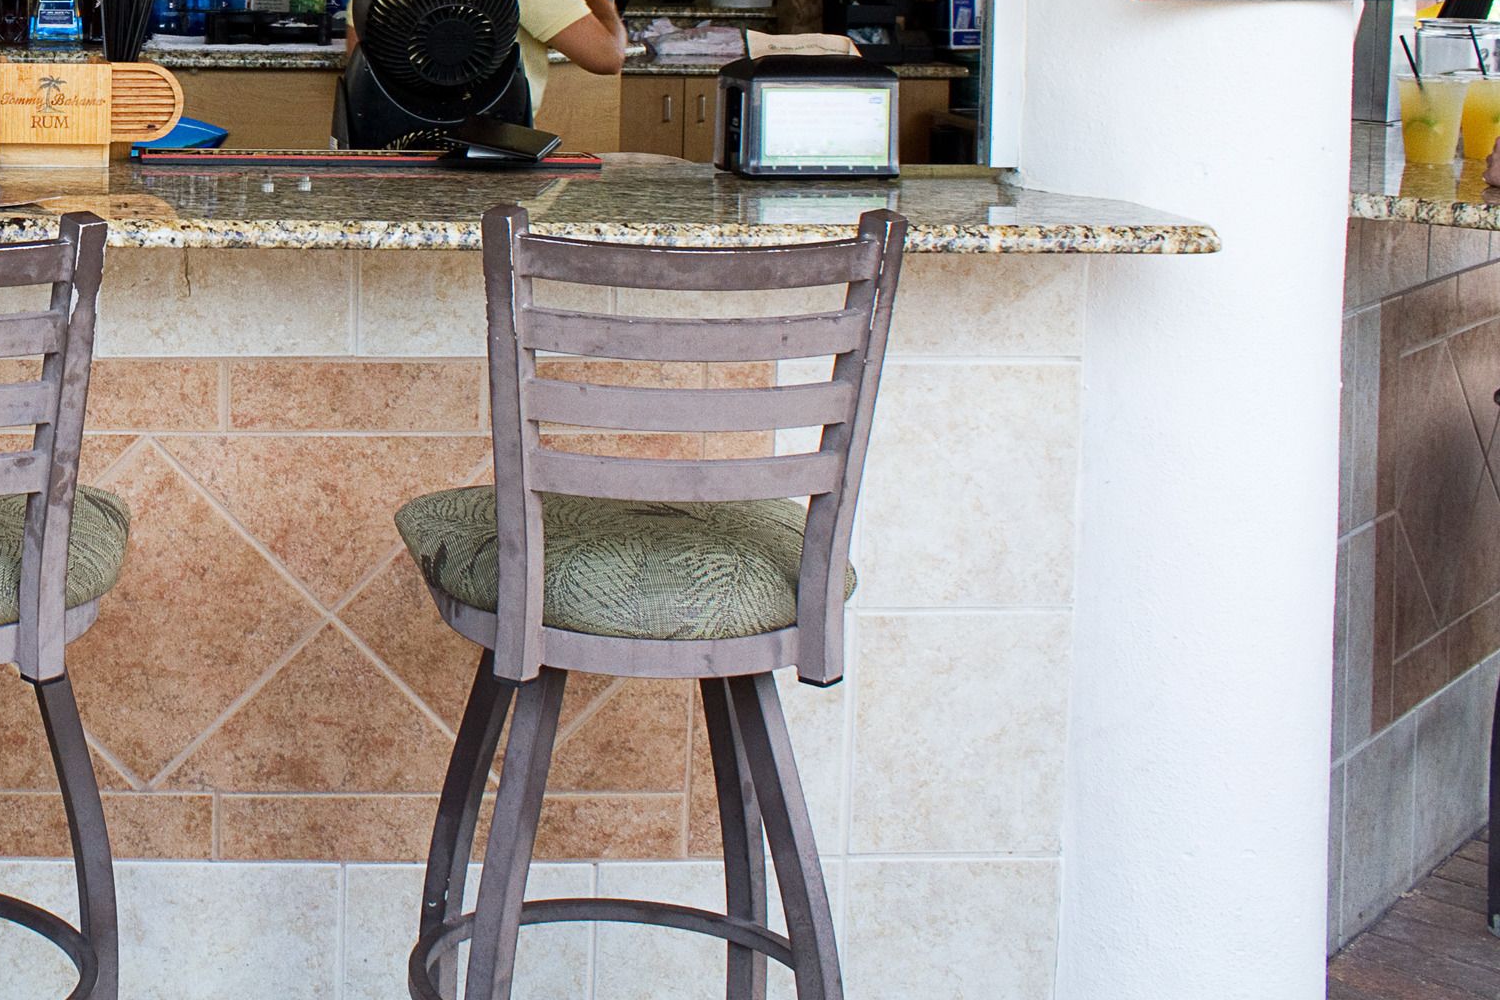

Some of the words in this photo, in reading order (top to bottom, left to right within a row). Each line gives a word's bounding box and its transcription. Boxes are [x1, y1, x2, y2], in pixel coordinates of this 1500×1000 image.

[0, 93, 45, 112] Tommy
[50, 93, 104, 108] Bahama
[30, 115, 69, 129] RUM
